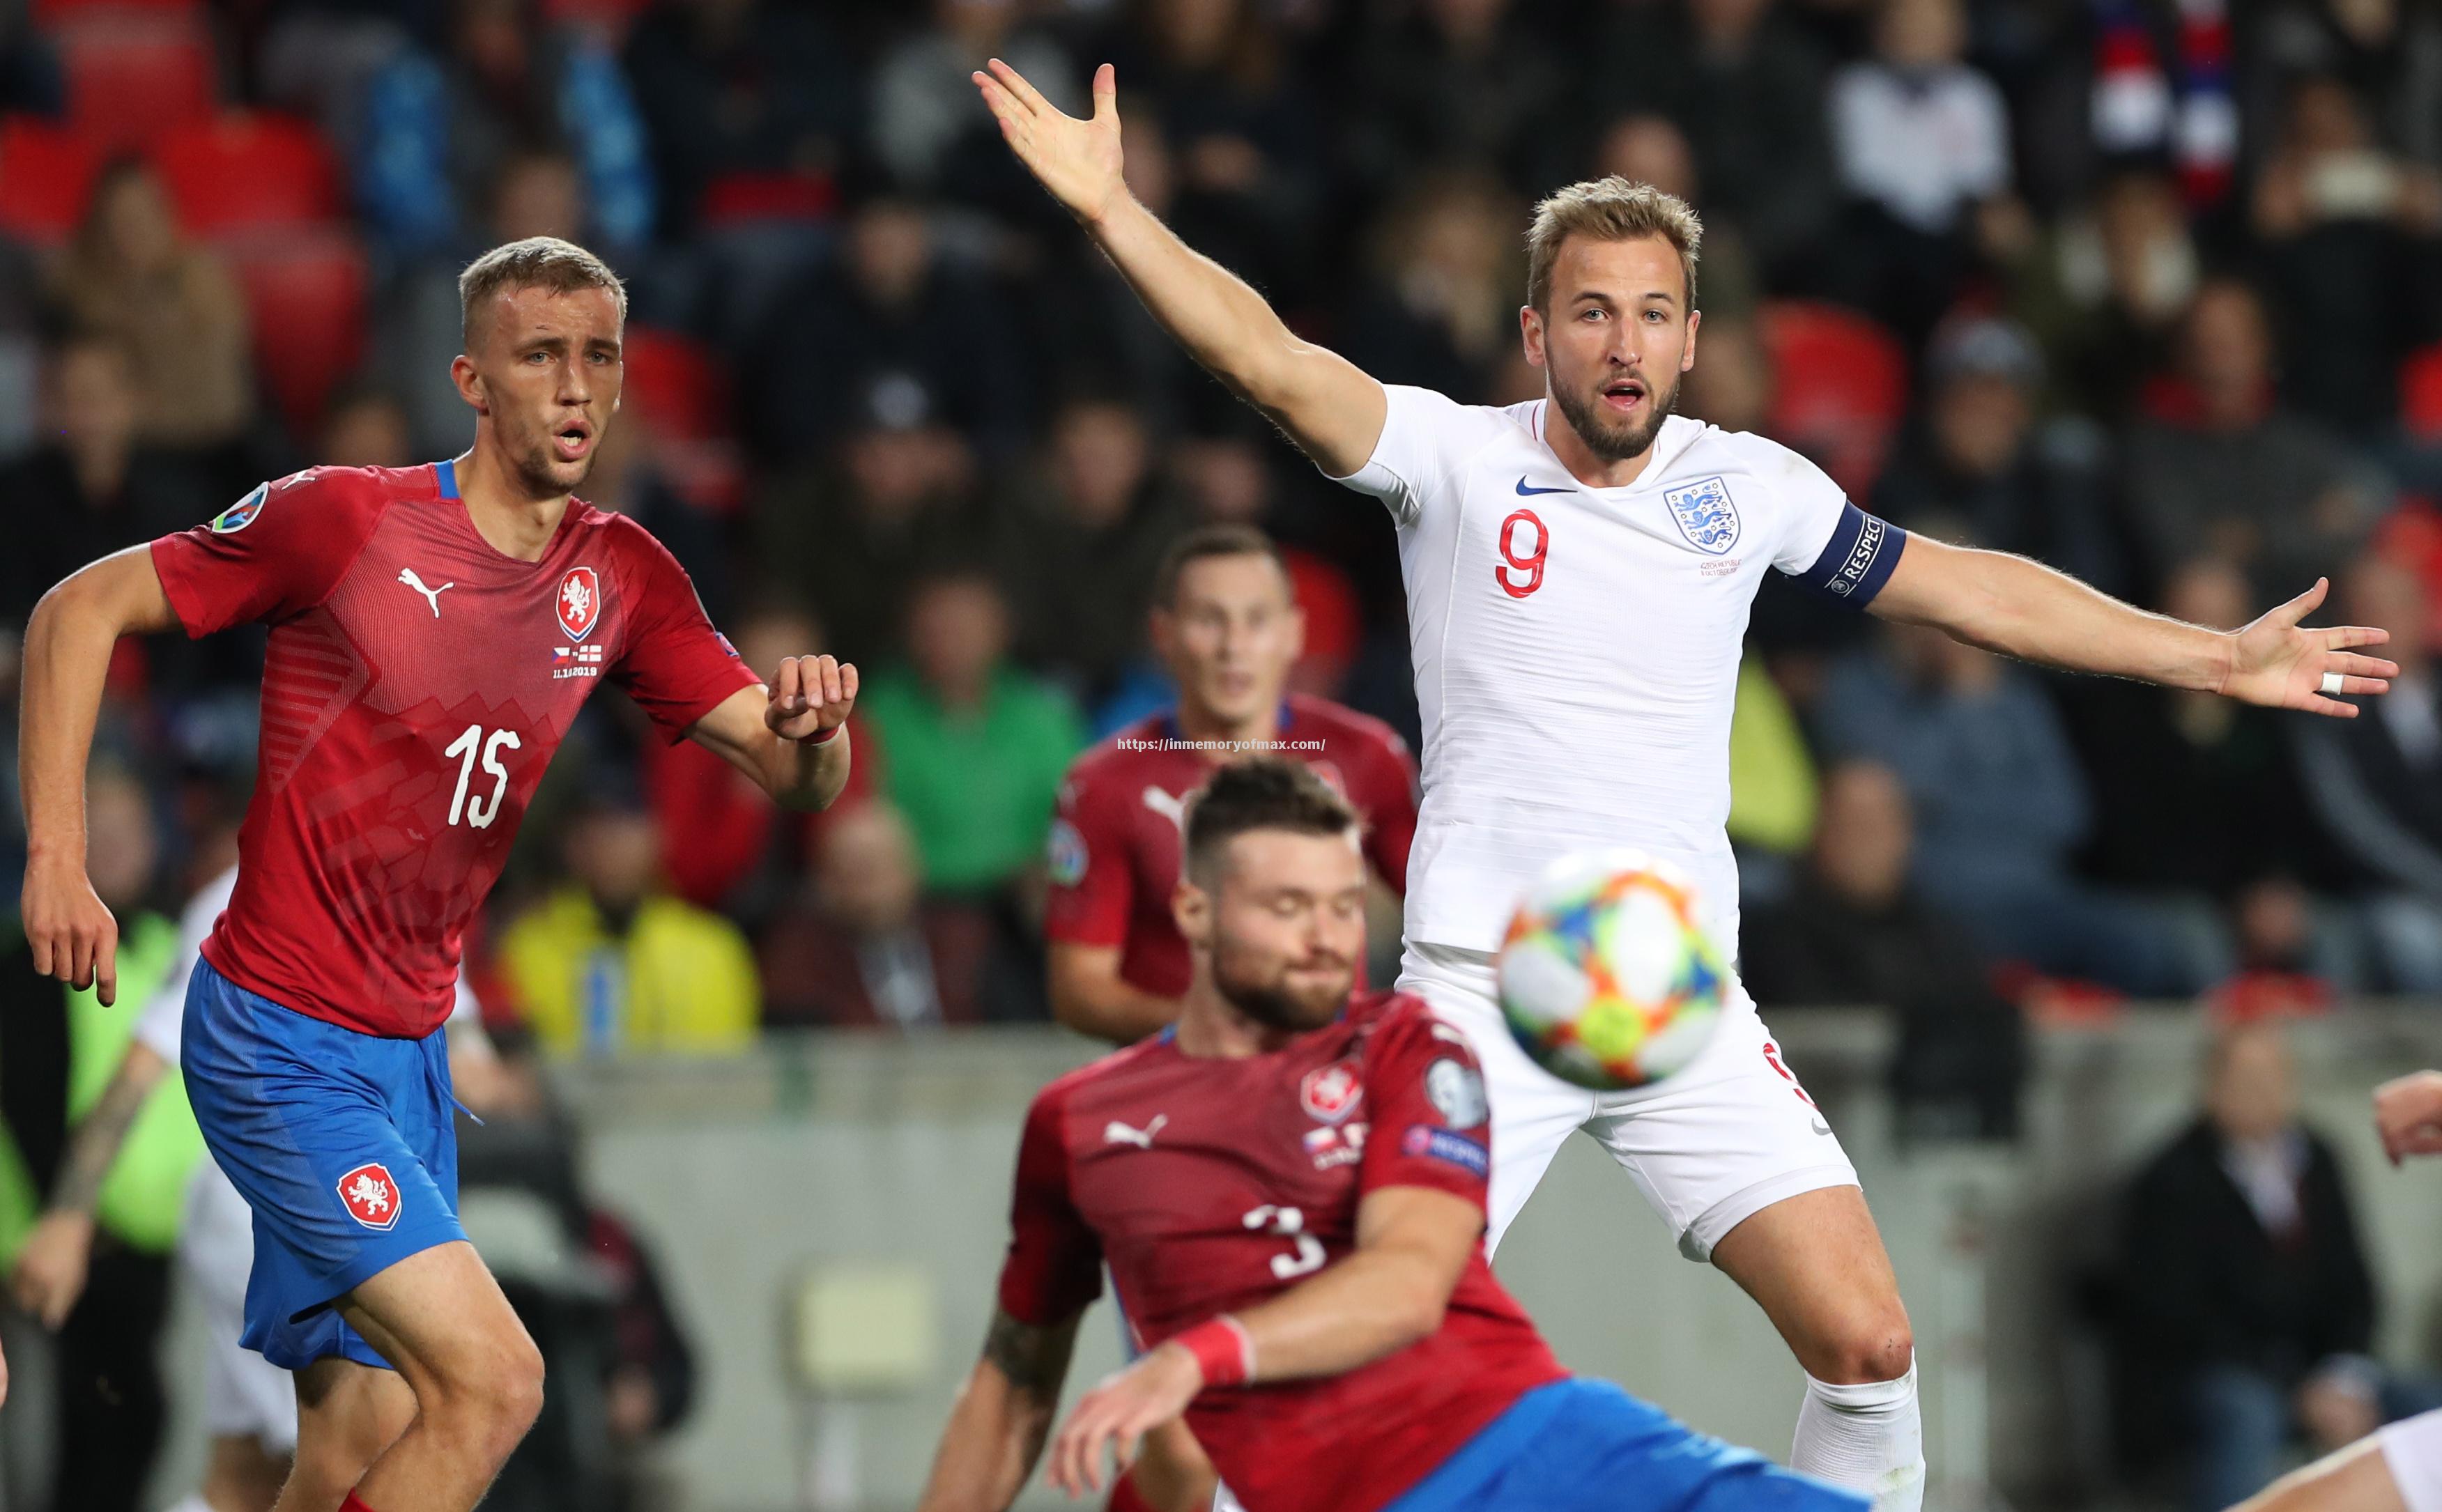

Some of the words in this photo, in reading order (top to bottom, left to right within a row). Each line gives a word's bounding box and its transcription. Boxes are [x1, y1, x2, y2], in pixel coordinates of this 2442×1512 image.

[1495, 509, 1549, 598] 9
[1844, 517, 1880, 579] RESPECT
[445, 724, 521, 828] 15
[1242, 1204, 1326, 1279] 3
